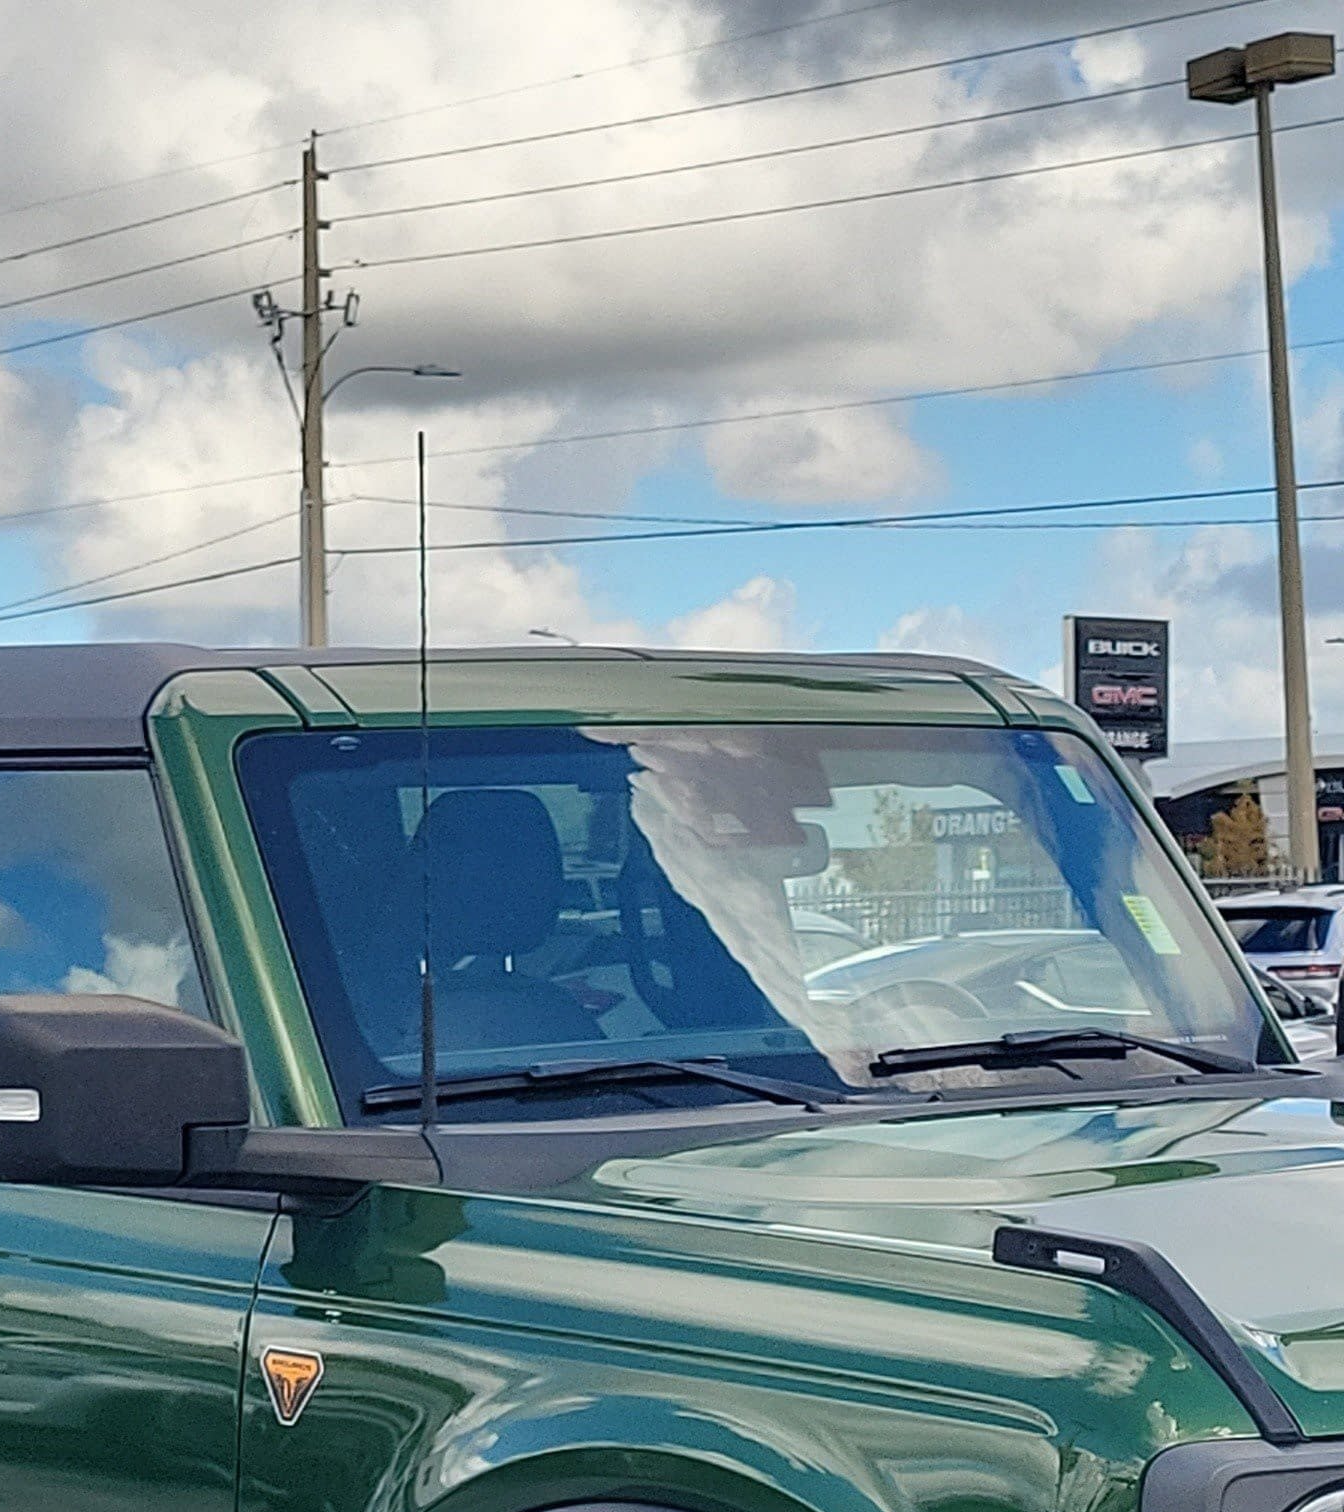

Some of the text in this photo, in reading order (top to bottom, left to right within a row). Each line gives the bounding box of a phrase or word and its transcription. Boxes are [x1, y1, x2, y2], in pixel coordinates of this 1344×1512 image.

[1088, 639, 1161, 656] BUICK
[1092, 686, 1158, 706] GMC
[1102, 731, 1152, 749] RANGE
